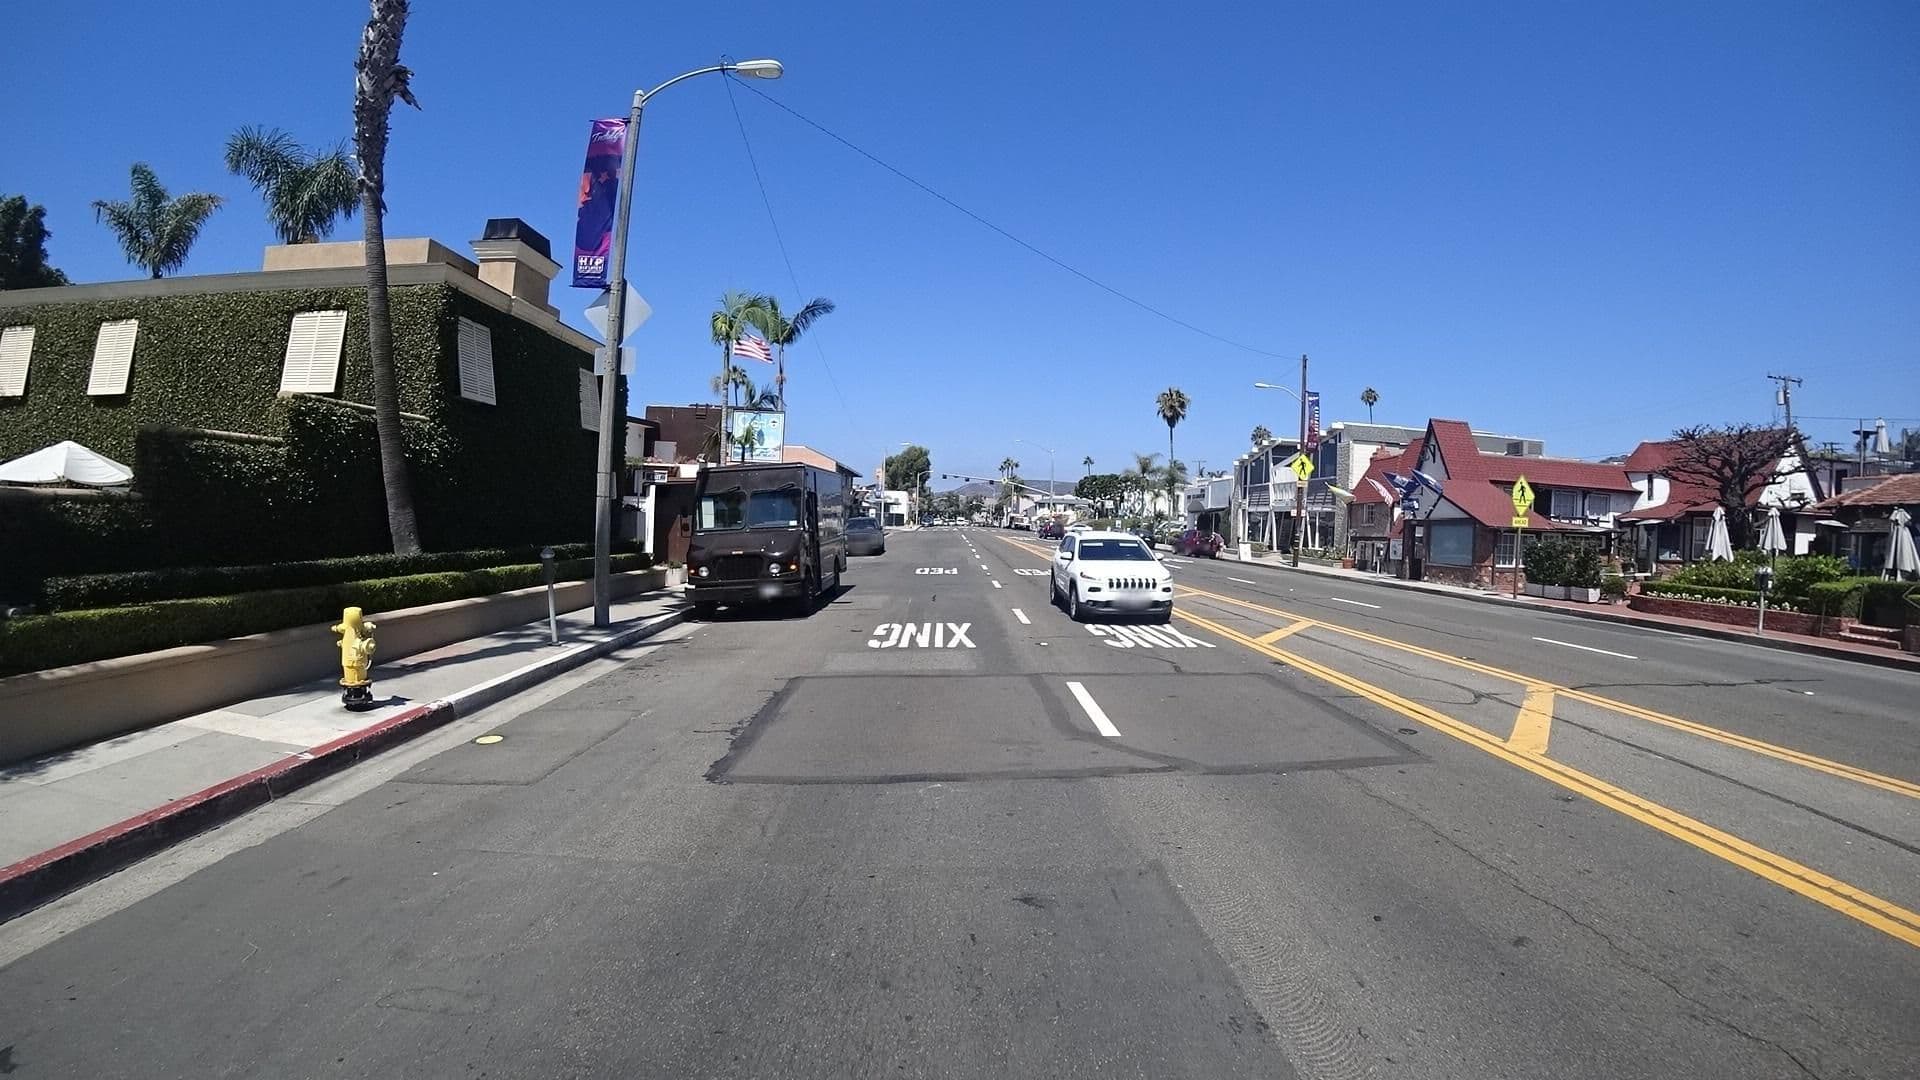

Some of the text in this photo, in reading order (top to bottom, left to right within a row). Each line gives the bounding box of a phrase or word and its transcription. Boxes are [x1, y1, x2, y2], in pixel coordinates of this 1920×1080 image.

[579, 257, 603, 266] HIP
[915, 567, 958, 575] PED
[867, 622, 977, 649] XING
[1084, 623, 1216, 649] XING
